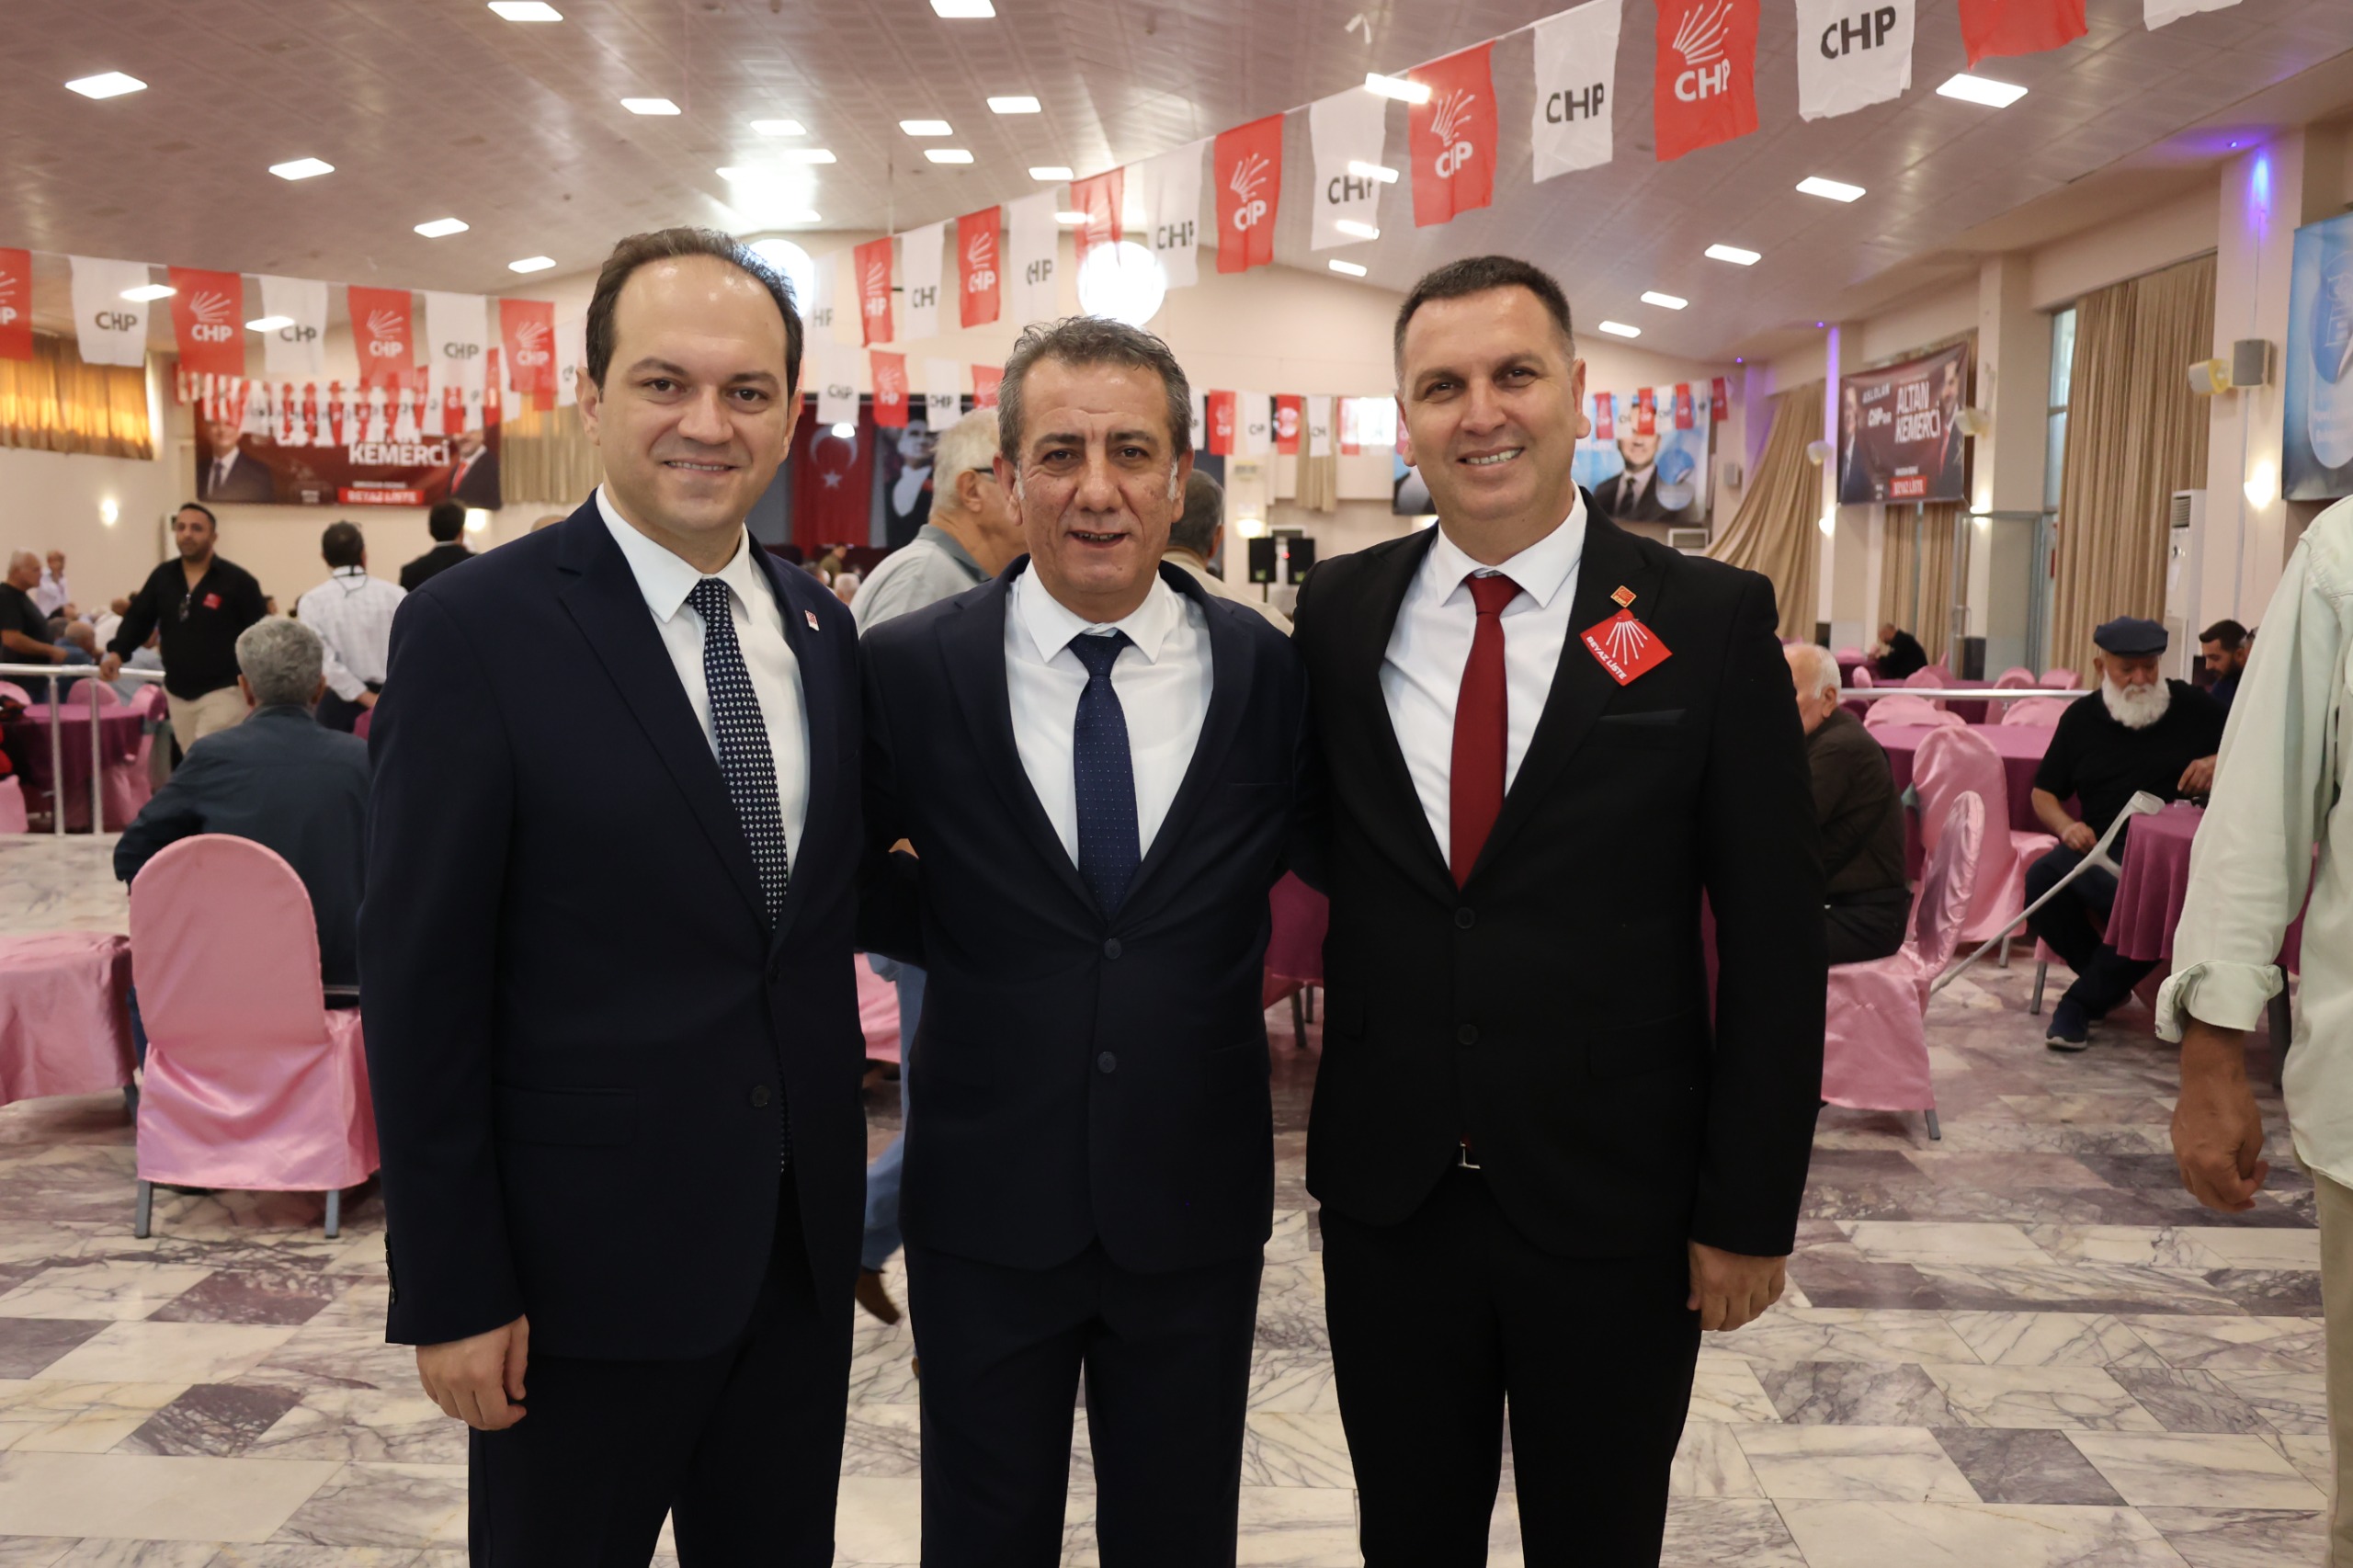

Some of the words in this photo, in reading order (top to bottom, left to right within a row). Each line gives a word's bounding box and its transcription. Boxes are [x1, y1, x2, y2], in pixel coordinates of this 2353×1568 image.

[1820, 6, 1896, 60] CHP
[1674, 58, 1731, 102] CHP
[1546, 82, 1604, 123] CHP
[95, 311, 138, 332] CHP
[191, 324, 233, 342] CHP
[279, 326, 317, 343] CHP
[369, 341, 404, 358] CHP
[444, 342, 480, 359] CHP
[517, 350, 551, 367] CHP
[1896, 381, 1929, 415] ALTAN
[1894, 400, 1941, 443] KEMERCİ
[348, 439, 451, 466] KEMERCİ
[1586, 636, 1609, 662] BEYAZ
[1606, 659, 1627, 679] LİSTE
